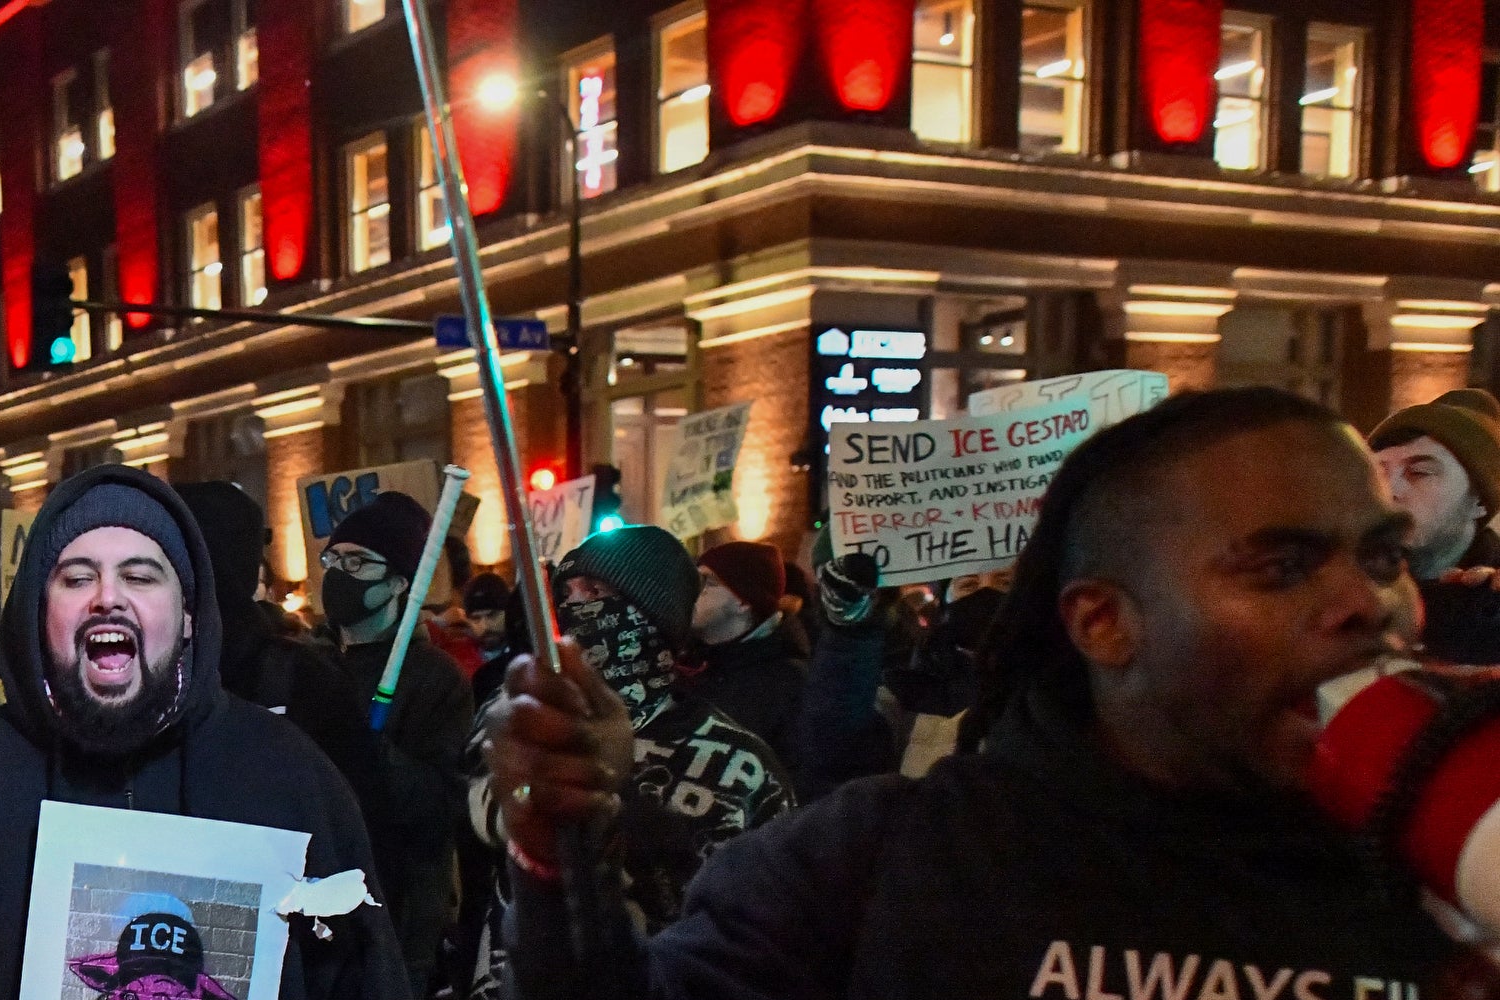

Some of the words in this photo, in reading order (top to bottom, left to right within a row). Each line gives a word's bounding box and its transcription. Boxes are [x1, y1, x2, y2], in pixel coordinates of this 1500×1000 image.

[843, 432, 936, 465] SEND
[948, 428, 999, 458] ICE
[1006, 409, 1090, 448] GESTAPO
[828, 471, 858, 489] AND
[861, 473, 896, 489] THE
[900, 463, 987, 487] POLITICIANS
[929, 484, 968, 501] AND
[833, 508, 951, 535] TERROR
[904, 529, 978, 562] THE
[129, 922, 188, 955] ICE
